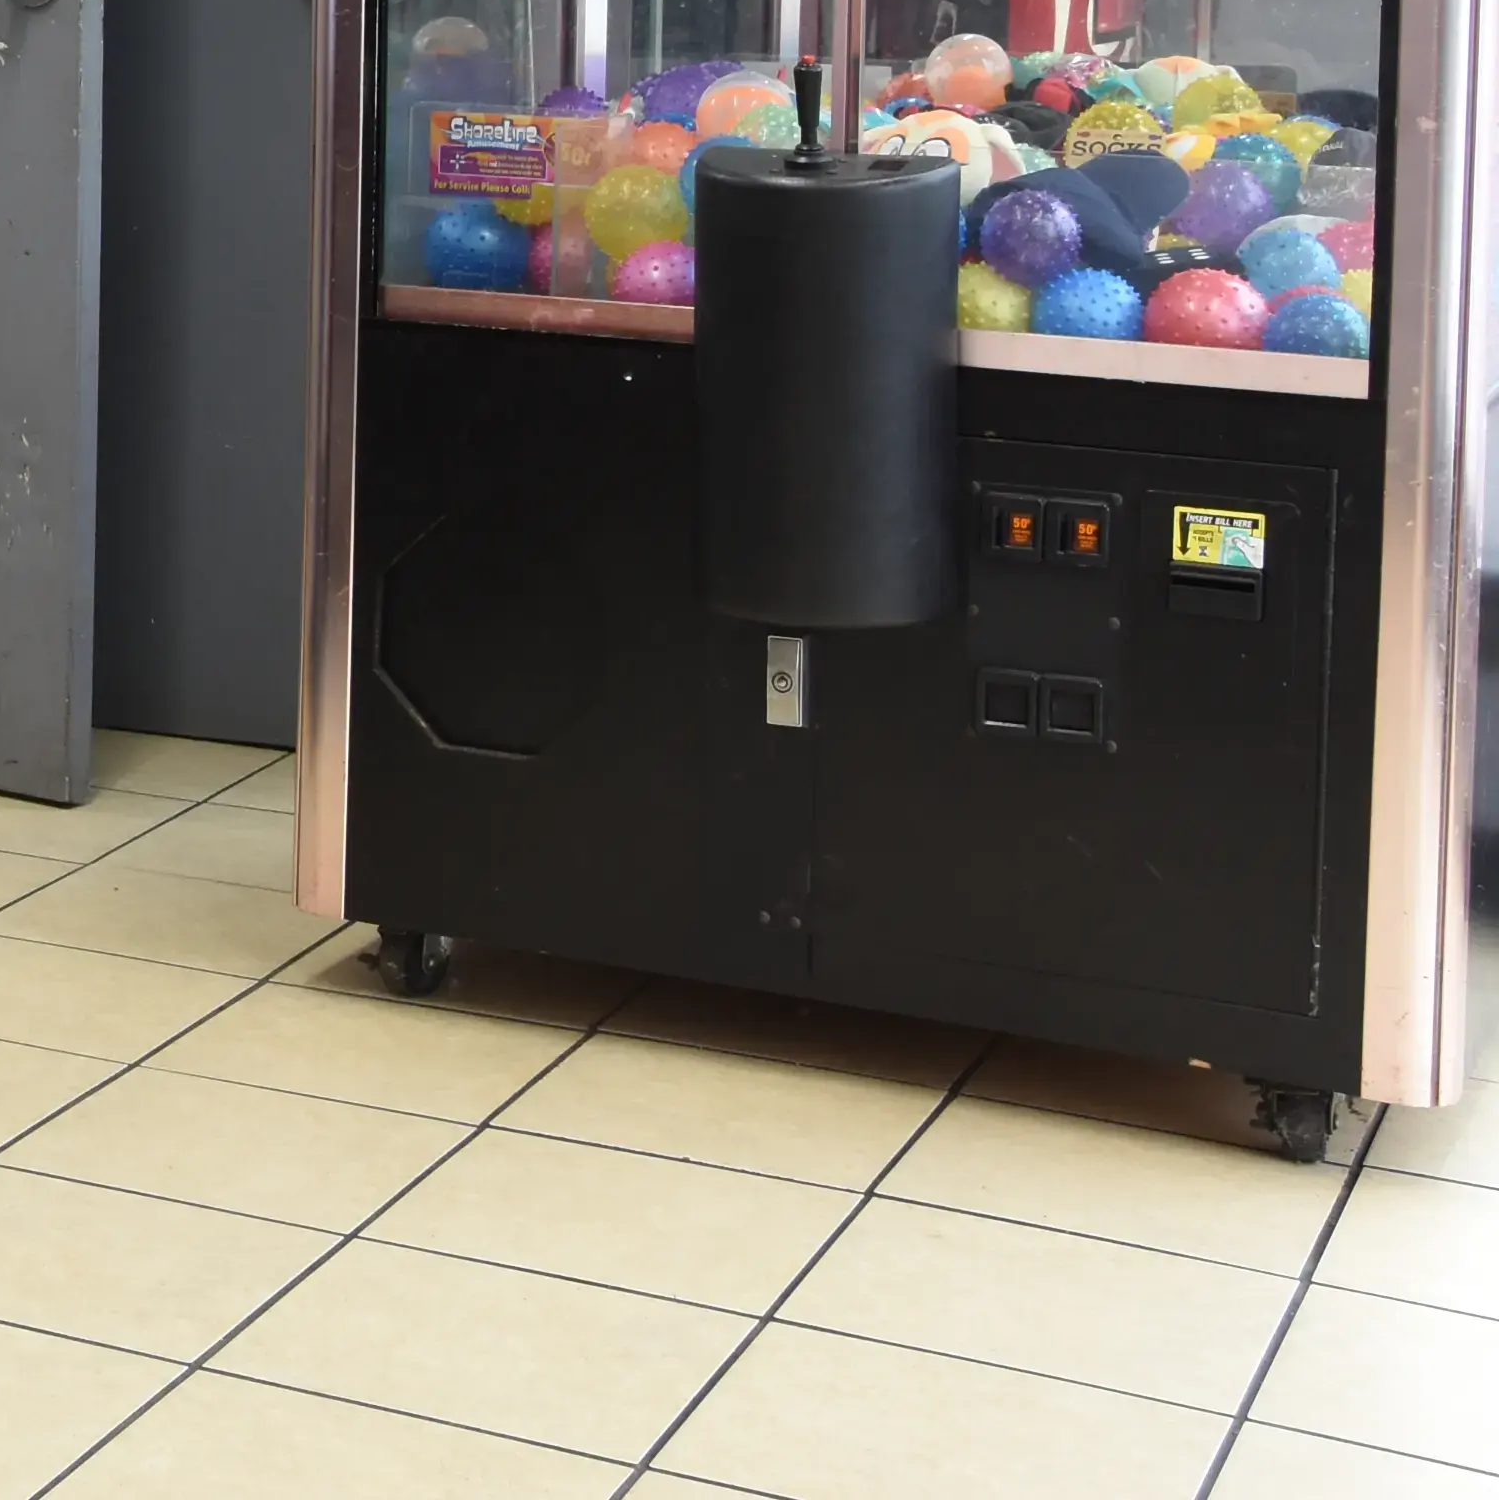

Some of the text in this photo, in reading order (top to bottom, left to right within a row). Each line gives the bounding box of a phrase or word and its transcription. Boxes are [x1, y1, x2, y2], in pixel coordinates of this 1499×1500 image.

[434, 179, 444, 189] For
[449, 180, 479, 191] Service
[481, 181, 510, 193] Please
[1185, 513, 1253, 528] INSERT BILL HERE
